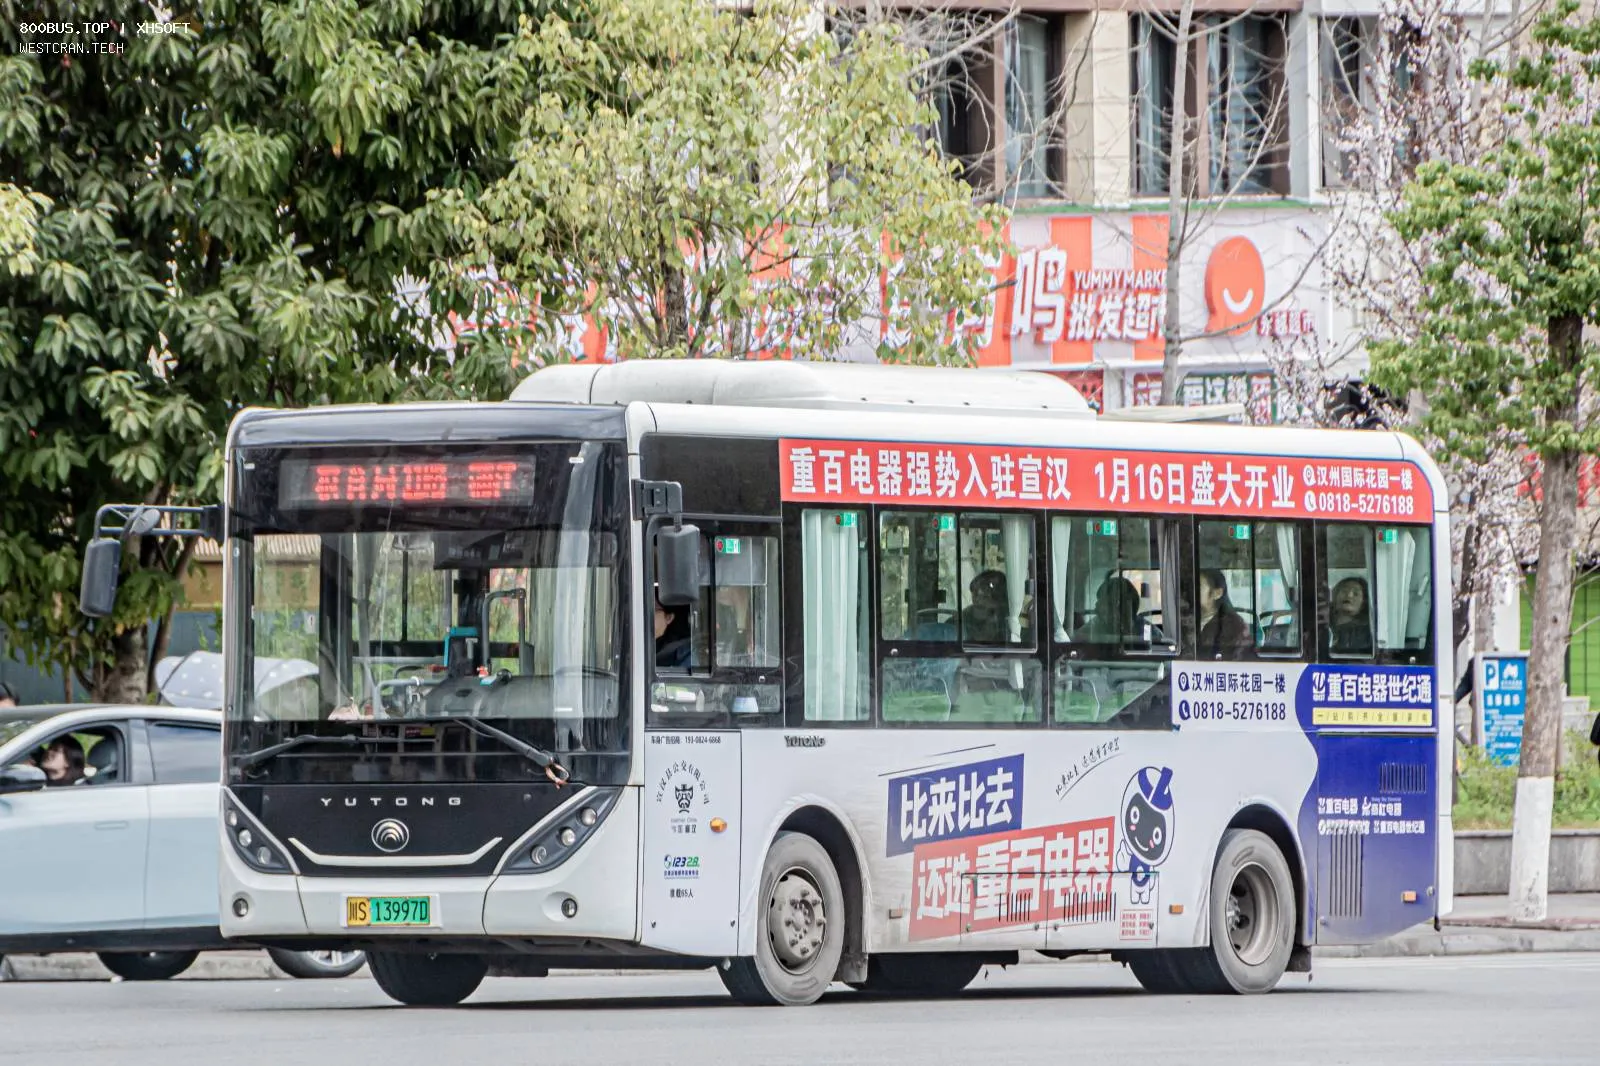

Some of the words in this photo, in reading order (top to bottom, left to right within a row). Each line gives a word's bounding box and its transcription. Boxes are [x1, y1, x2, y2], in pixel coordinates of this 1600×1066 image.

[1073, 270, 1123, 289] YUMMY
[1123, 270, 1169, 289] MARKE
[789, 447, 1071, 501] 重百电器强势入驻宣汉
[1094, 457, 1296, 509] 1月16日盛大开业
[1316, 465, 1414, 491] 汉州国际花园一楼
[1319, 489, 1414, 516] 0818-5276188
[1191, 673, 1287, 693] 汉州国际花园一楼
[1486, 664, 1496, 687] P
[1327, 674, 1432, 703] 重百电器世纪通
[1193, 703, 1287, 721] 0818-5276188
[321, 797, 462, 807] YUTONG
[900, 767, 1014, 843] 比来比去
[916, 827, 1110, 923] 还选重百电器
[349, 901, 367, 921] 川S
[375, 901, 428, 921] 13997D
